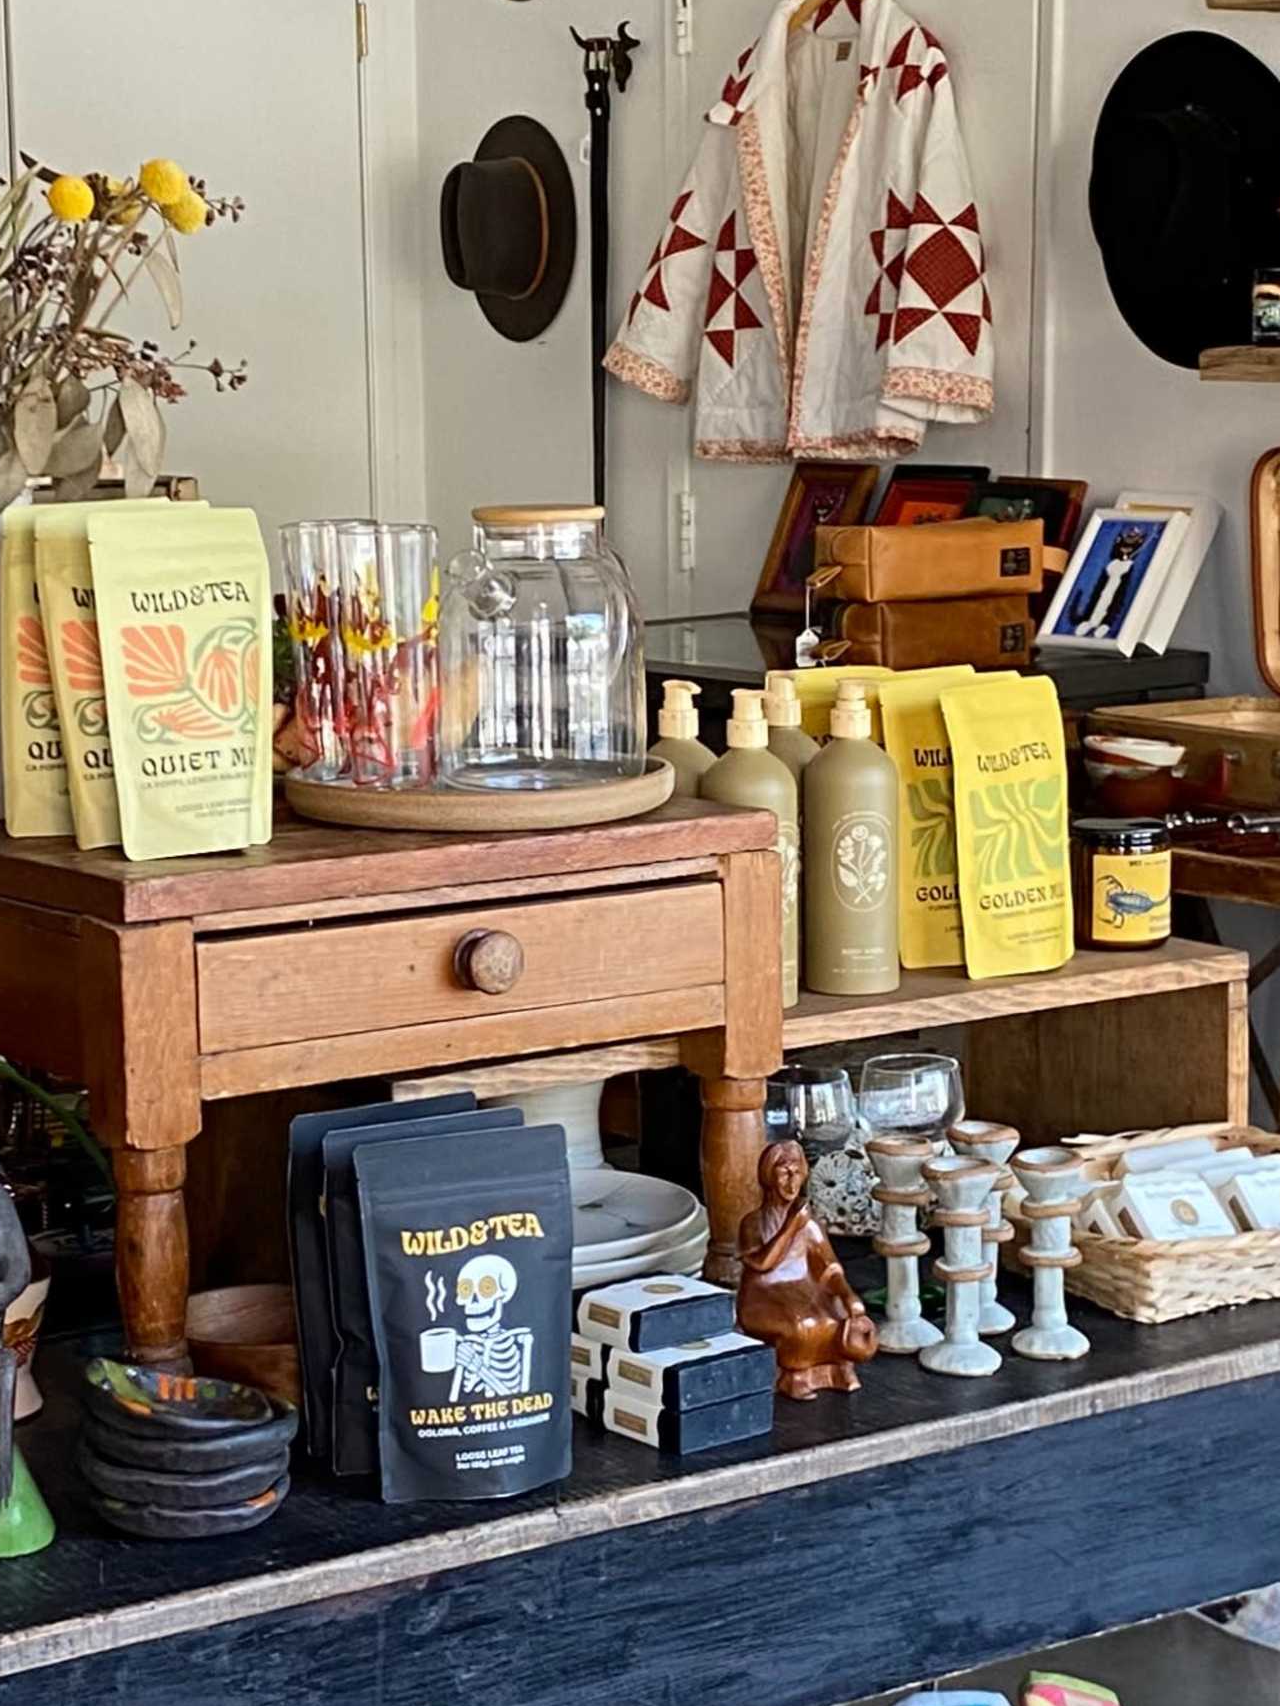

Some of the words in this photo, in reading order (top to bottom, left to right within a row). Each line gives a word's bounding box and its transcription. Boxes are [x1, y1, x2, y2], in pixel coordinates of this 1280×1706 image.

[131, 581, 251, 613] WILD&TEA
[141, 750, 221, 777] QUIET
[979, 887, 1047, 910] GOLDEN
[400, 1212, 545, 1256] WILD&TEA
[409, 1406, 467, 1426] WAKE
[470, 1400, 509, 1421] THE
[511, 1392, 554, 1416] DEAD
[463, 1422, 498, 1435] COFFEE
